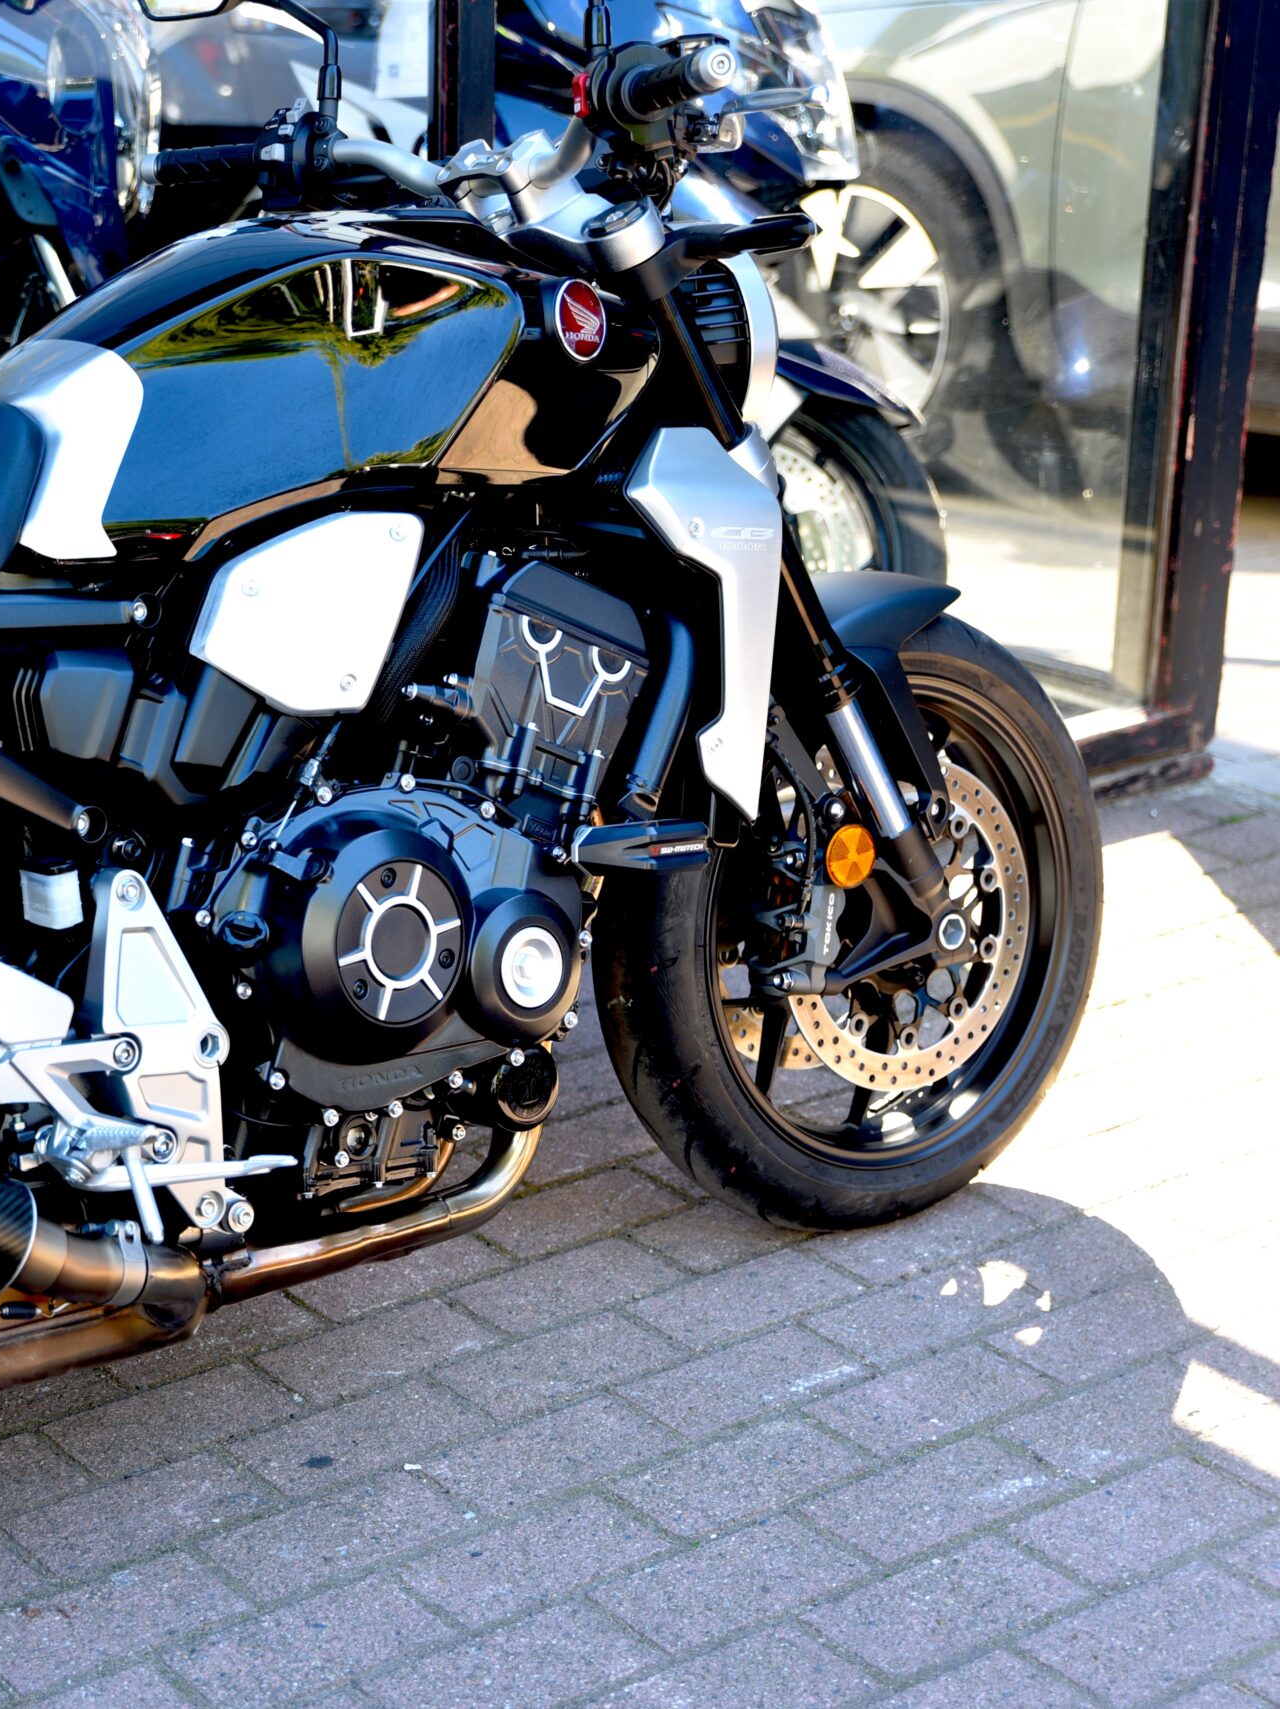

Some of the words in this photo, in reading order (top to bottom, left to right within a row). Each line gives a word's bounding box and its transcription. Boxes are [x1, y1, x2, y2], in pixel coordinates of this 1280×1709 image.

[565, 331, 600, 343] HONDA
[660, 843, 704, 855] SW-MOTECH
[823, 892, 836, 956] TOKICO
